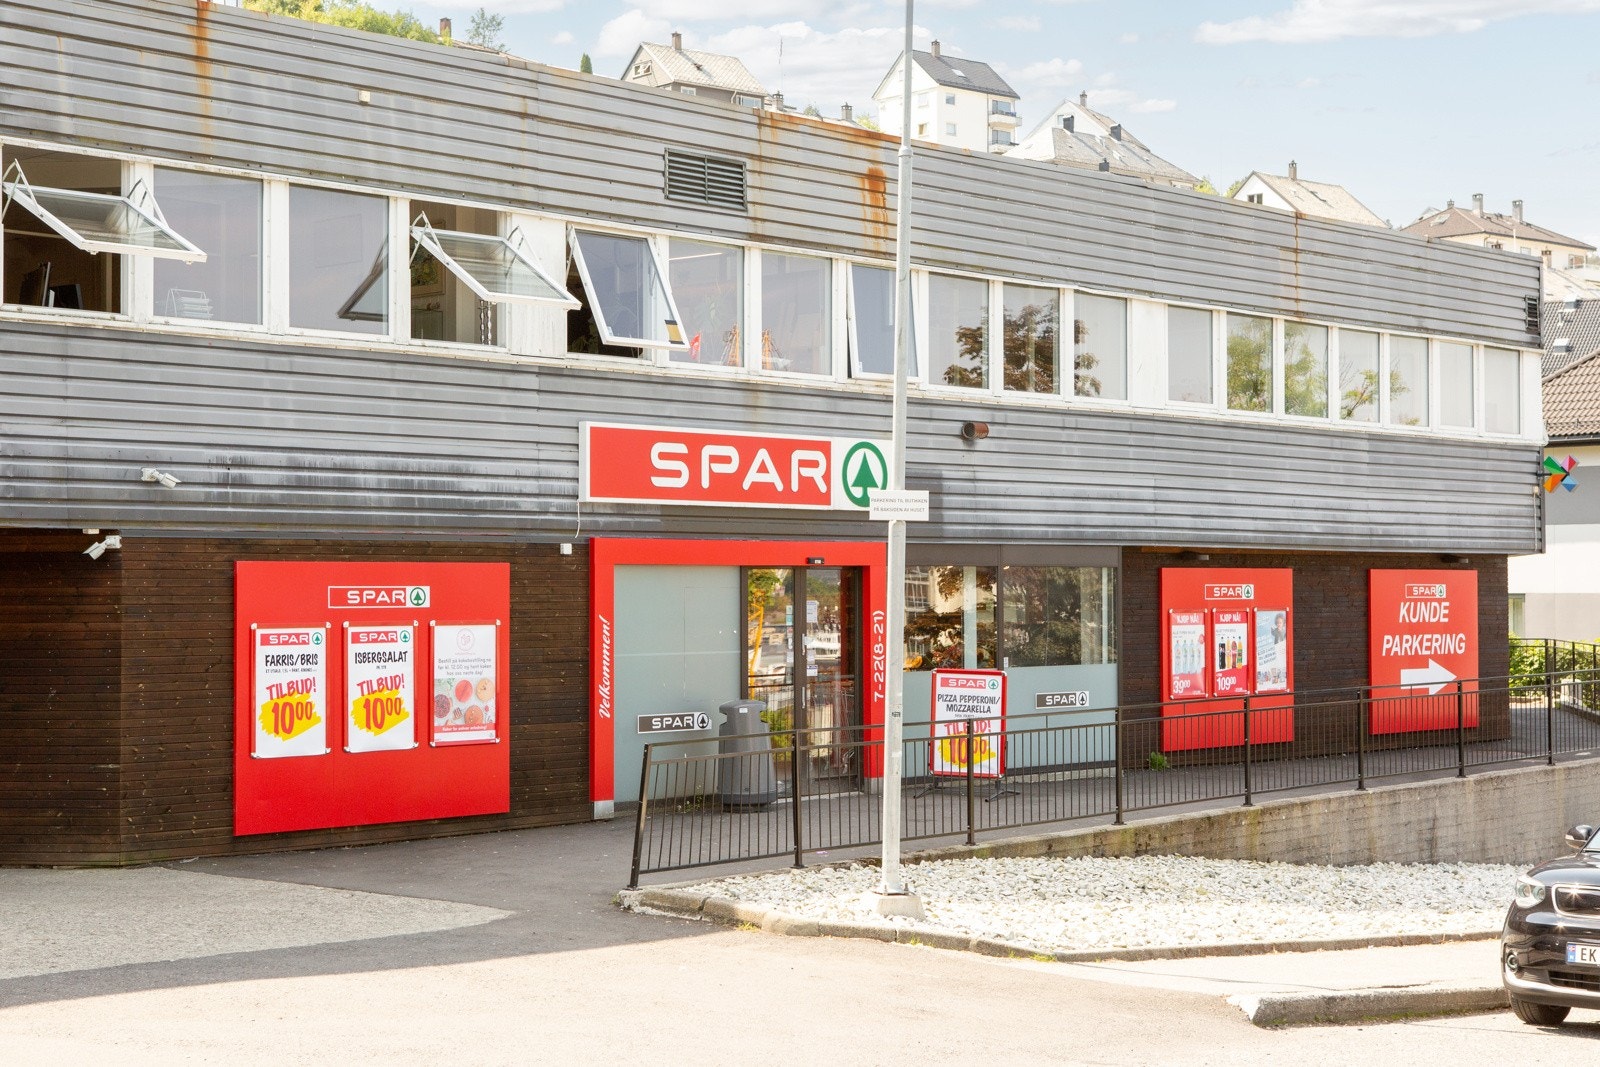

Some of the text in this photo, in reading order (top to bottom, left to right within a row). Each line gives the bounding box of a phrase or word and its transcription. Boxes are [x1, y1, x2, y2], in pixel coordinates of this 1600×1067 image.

[650, 441, 828, 494] SPAR
[347, 590, 405, 604] SPAR
[1213, 587, 1242, 597] SPAR
[1412, 586, 1437, 595] SPAR
[1399, 601, 1450, 623] KUNDE
[269, 635, 309, 644] SPAR
[359, 634, 397, 642] SPAR
[1382, 633, 1466, 657] PARKERING
[265, 653, 318, 667] FARRIS/BRIS
[354, 650, 408, 664] ISBERGSALAT
[598, 614, 611, 719] Velkommen!
[266, 676, 317, 701] TILBUD!
[356, 673, 405, 697] TILBUD!
[949, 679, 985, 688] SPAR
[937, 693, 1001, 705] PIZZA PEPPERONI/
[1045, 695, 1076, 706] SPAR
[946, 704, 992, 714] MOZZARELLA
[651, 716, 694, 729] SPAR
[1581, 947, 1597, 963] EK
